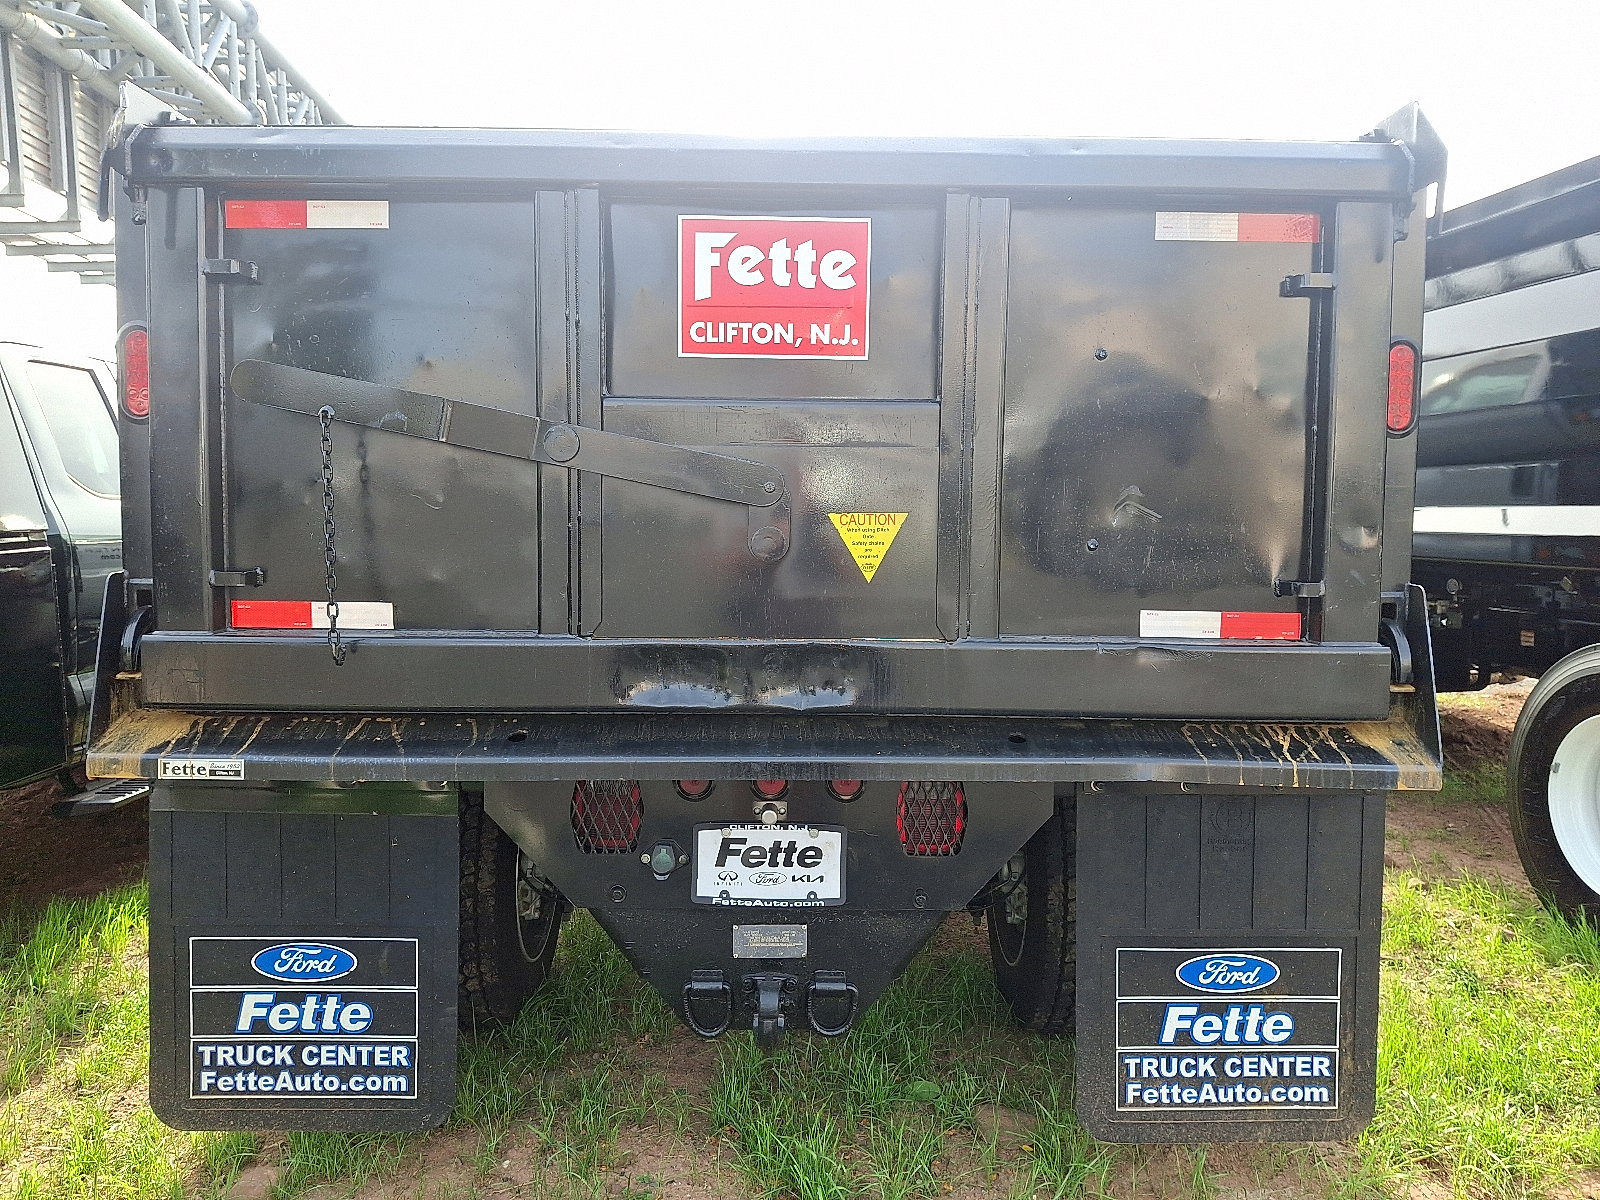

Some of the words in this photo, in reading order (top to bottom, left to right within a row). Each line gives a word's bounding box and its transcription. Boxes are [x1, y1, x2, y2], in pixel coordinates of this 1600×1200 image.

[694, 231, 858, 301] Fette
[689, 321, 803, 349] CLIFTON,
[810, 323, 859, 346] N.J.
[839, 513, 896, 526] CAUTION
[162, 761, 207, 776] Fette
[715, 838, 823, 868] Fette
[755, 873, 782, 884] Ford
[791, 874, 825, 884] KIA
[712, 898, 825, 907] FetteAuto.com
[273, 947, 338, 973] Ford
[1198, 959, 1262, 985] Ford
[236, 992, 372, 1032] Fette
[1160, 1004, 1294, 1044] Fette
[198, 1045, 295, 1067] TRUCK
[301, 1045, 411, 1067] CENTER
[1123, 1056, 1217, 1078] TRUCK
[1223, 1056, 1332, 1078] CENTER
[200, 1069, 409, 1093] FetteAuto.com
[1125, 1082, 1329, 1104] FetteAuto.com
